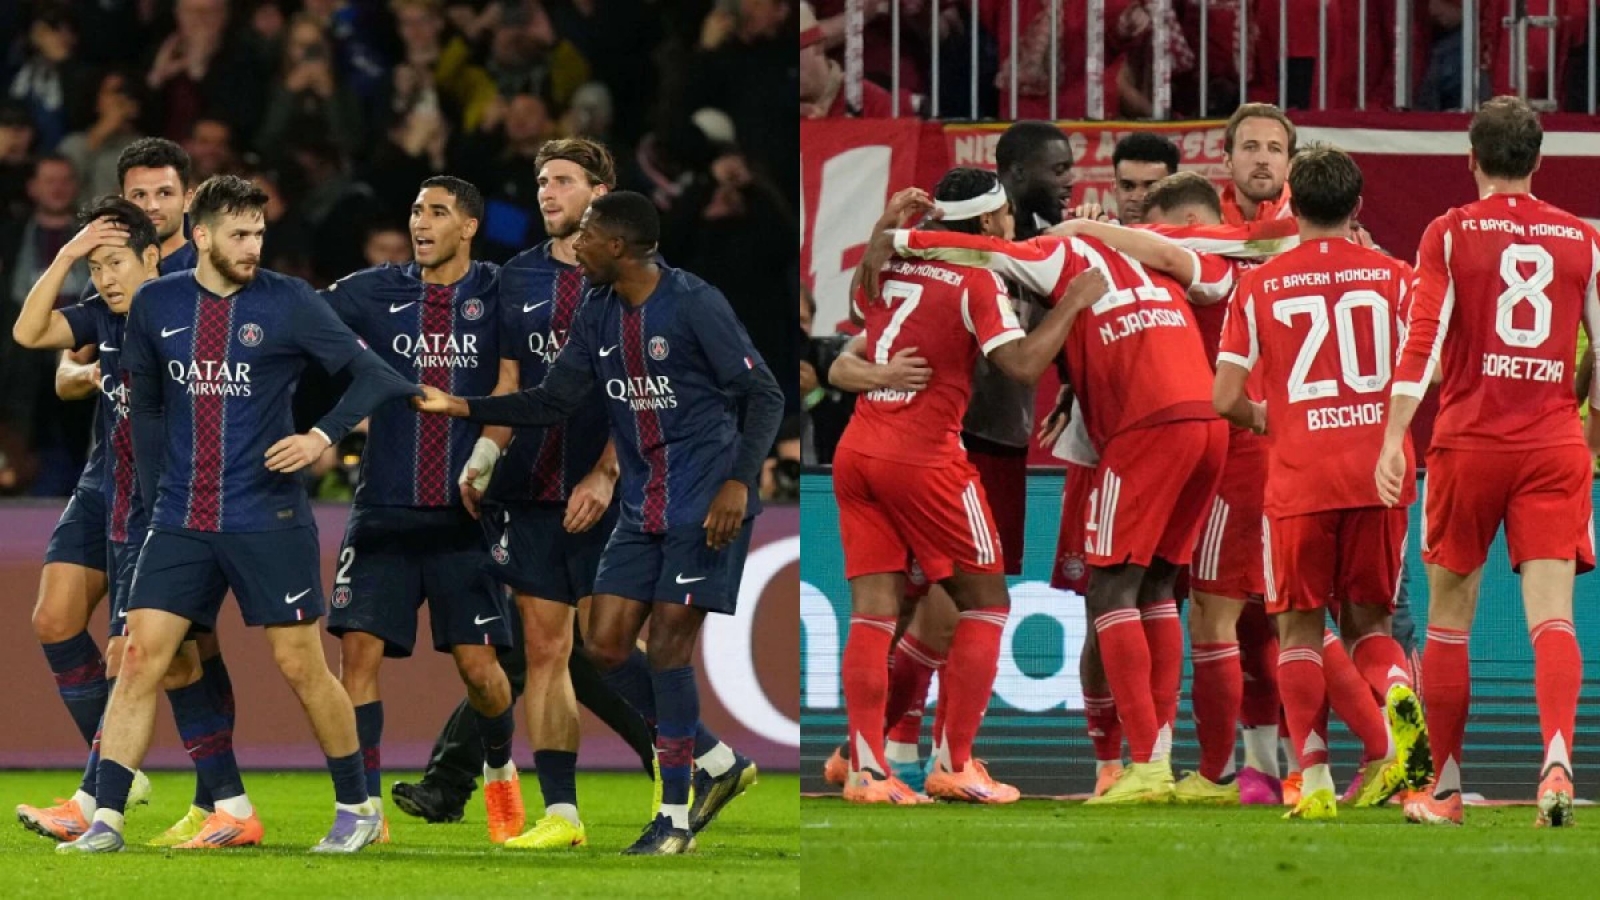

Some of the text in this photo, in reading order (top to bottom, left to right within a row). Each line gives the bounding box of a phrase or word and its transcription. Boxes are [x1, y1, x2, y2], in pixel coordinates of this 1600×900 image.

[1461, 219, 1477, 231] FC
[1480, 218, 1525, 236] BAYERN
[1263, 278, 1280, 293] FC
[1283, 271, 1331, 289] BAYERN
[1495, 243, 1554, 349] 8
[875, 279, 924, 365] 7
[392, 332, 479, 358] QATAR
[1272, 289, 1392, 404] 20
[168, 359, 251, 384] QATAR
[412, 355, 479, 368] AIRWAYS
[186, 382, 252, 397] AIRWAYS
[605, 375, 675, 403] QATAR
[629, 395, 678, 411] AIRWAYS
[1307, 403, 1384, 431] BISCHOF
[335, 547, 356, 584] 2
